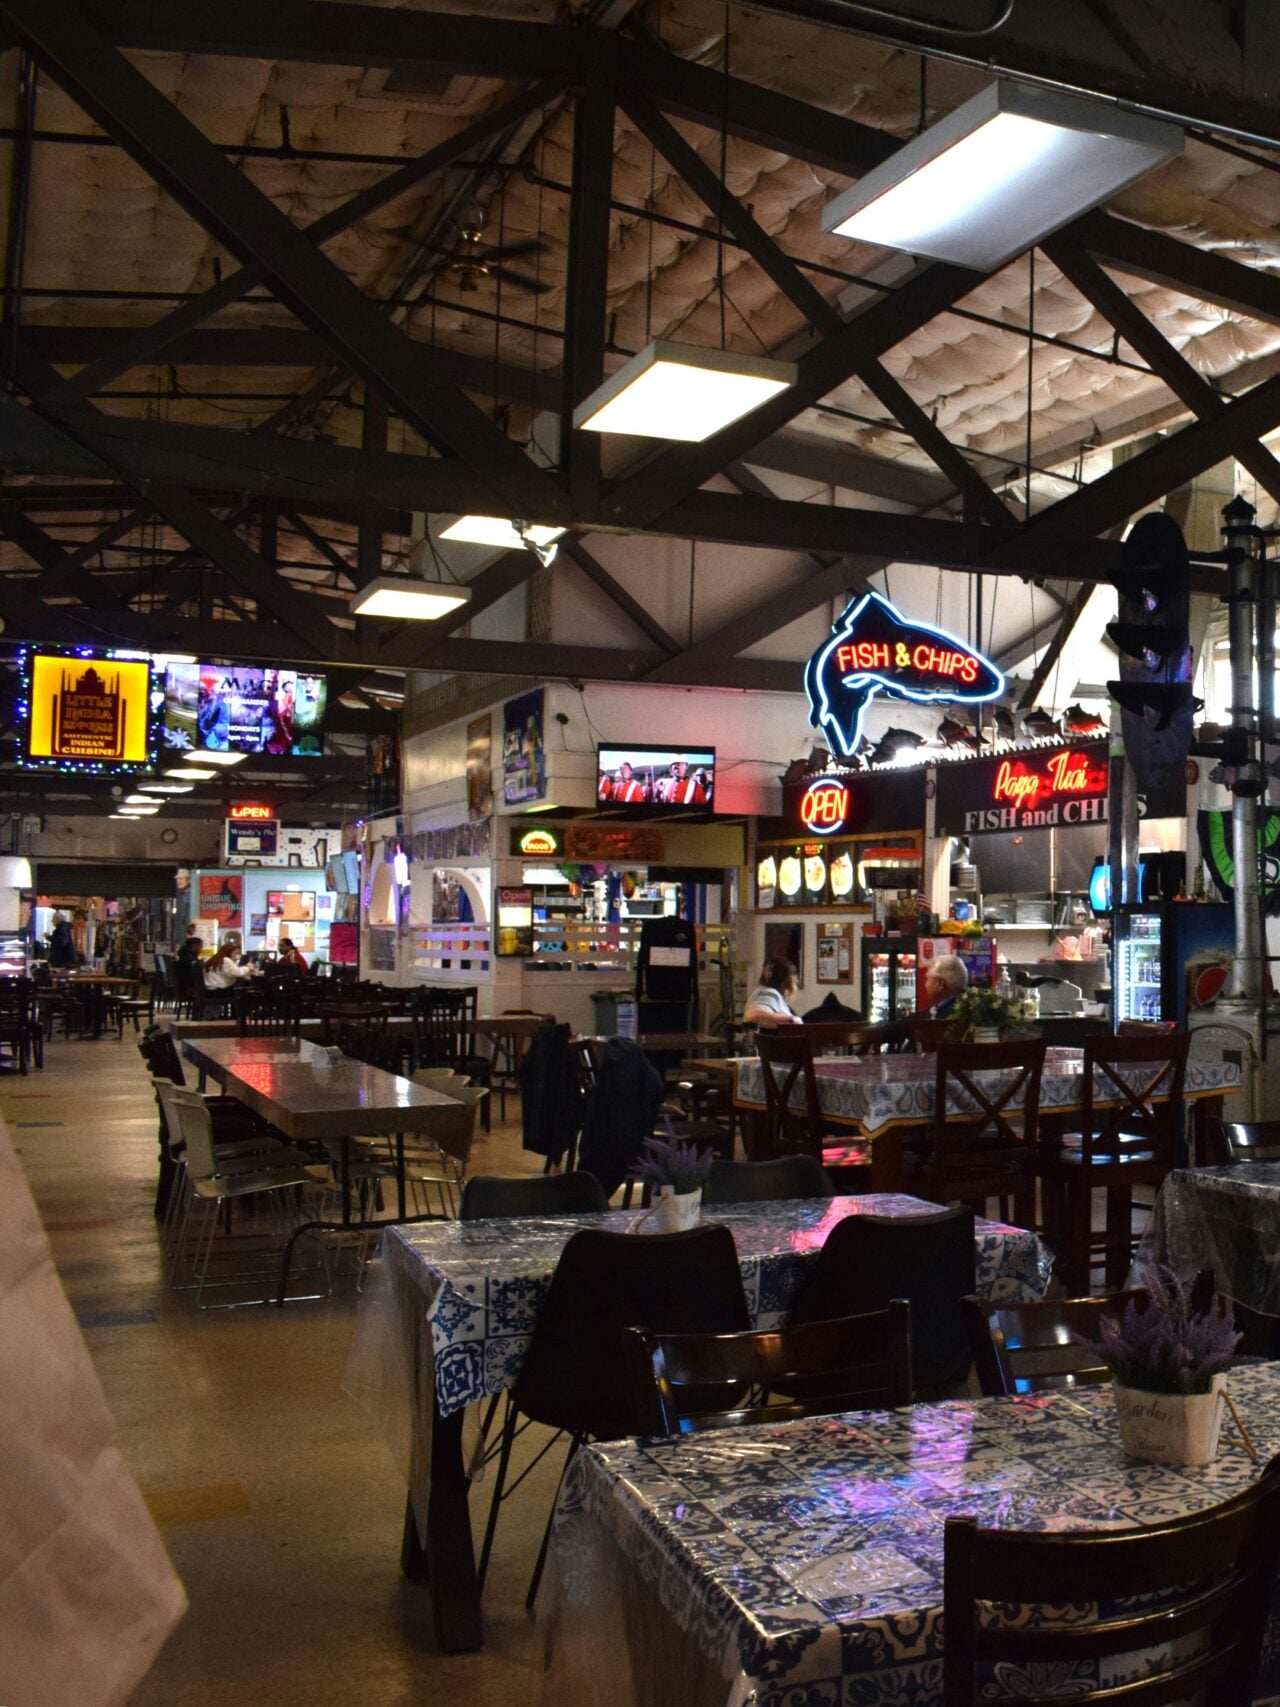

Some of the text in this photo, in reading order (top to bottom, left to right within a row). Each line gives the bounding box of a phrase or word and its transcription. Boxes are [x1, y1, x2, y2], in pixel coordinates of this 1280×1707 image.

[837, 642, 979, 682] FISH & CHIPS
[66, 694, 113, 708] LITTLE
[65, 707, 113, 721] INDIA
[62, 733, 114, 741] AUTHENTIC
[70, 739, 105, 747] INDIAN
[61, 746, 116, 756] CUISINE
[995, 751, 1089, 808] Papa Thai
[800, 789, 849, 823] OPEN
[964, 807, 1017, 832] FISH
[1021, 803, 1059, 827] and
[230, 827, 262, 837] Wendy's
[527, 843, 549, 851] TACOS
[200, 894, 231, 902] UNIQUE
[502, 890, 530, 902] Open
[200, 903, 242, 911] SHOPPING
